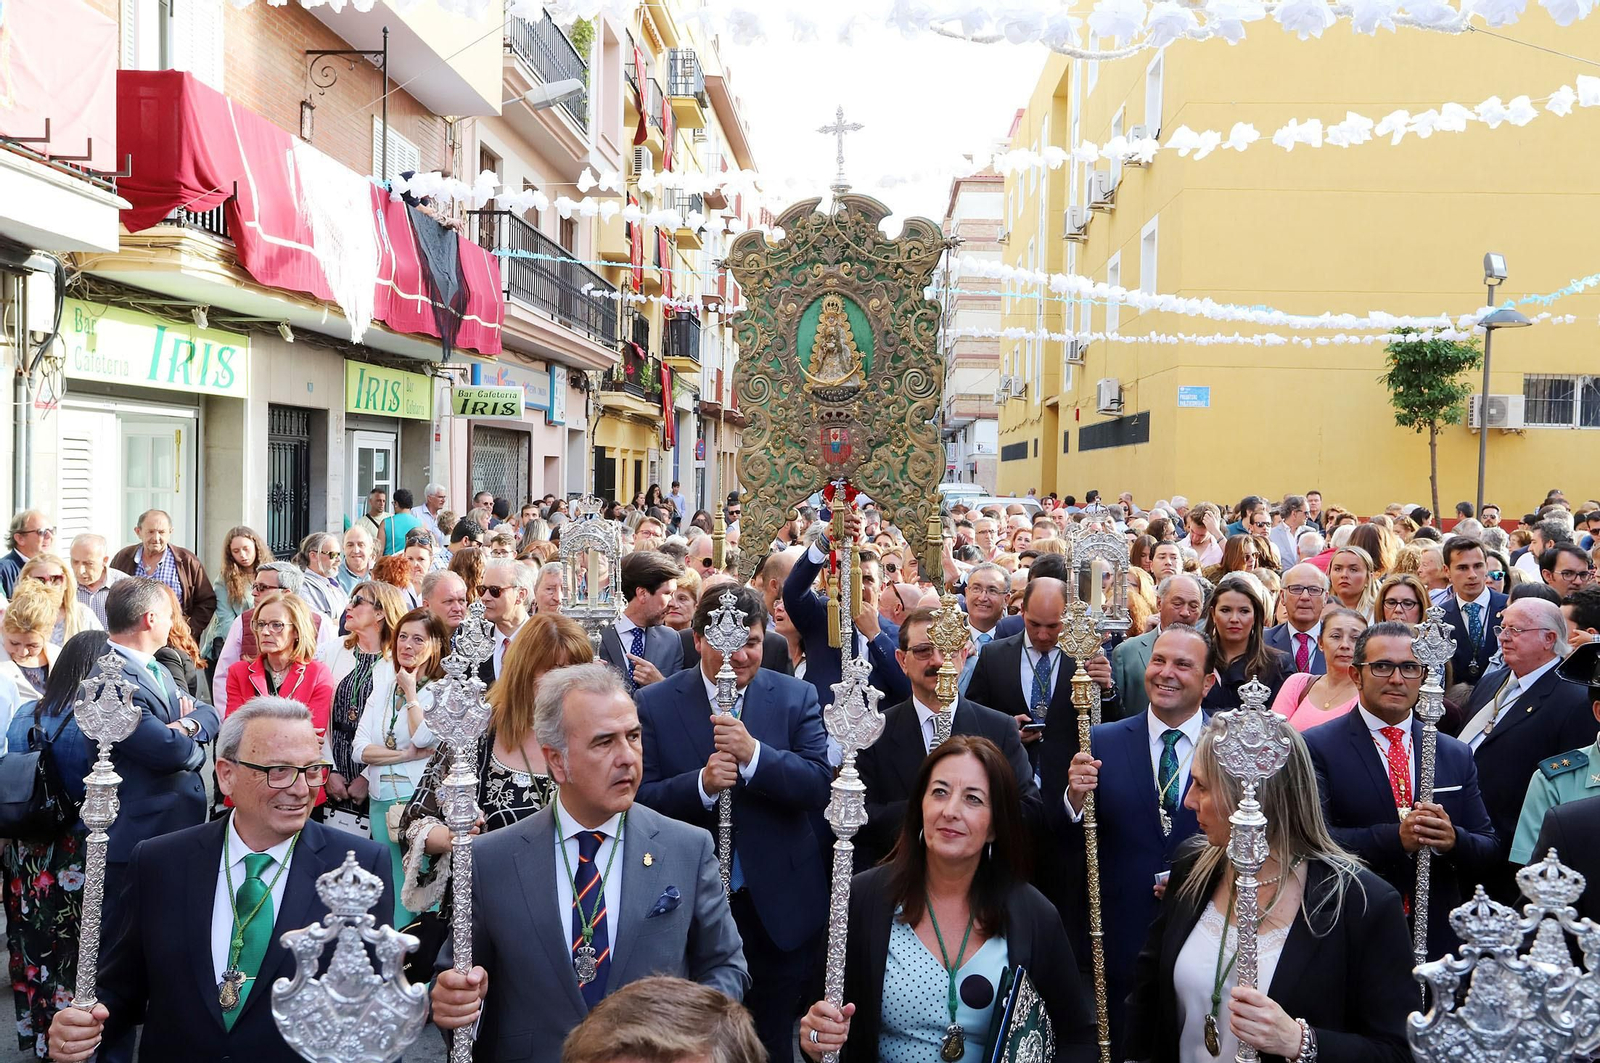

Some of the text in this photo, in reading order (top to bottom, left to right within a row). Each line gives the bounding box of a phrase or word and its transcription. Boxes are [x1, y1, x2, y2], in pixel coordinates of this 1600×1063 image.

[74, 306, 98, 335] Bar
[147, 323, 237, 389] IRIS
[354, 368, 402, 413] IRIS
[457, 389, 473, 398] Bar
[459, 398, 517, 416] IRIS
